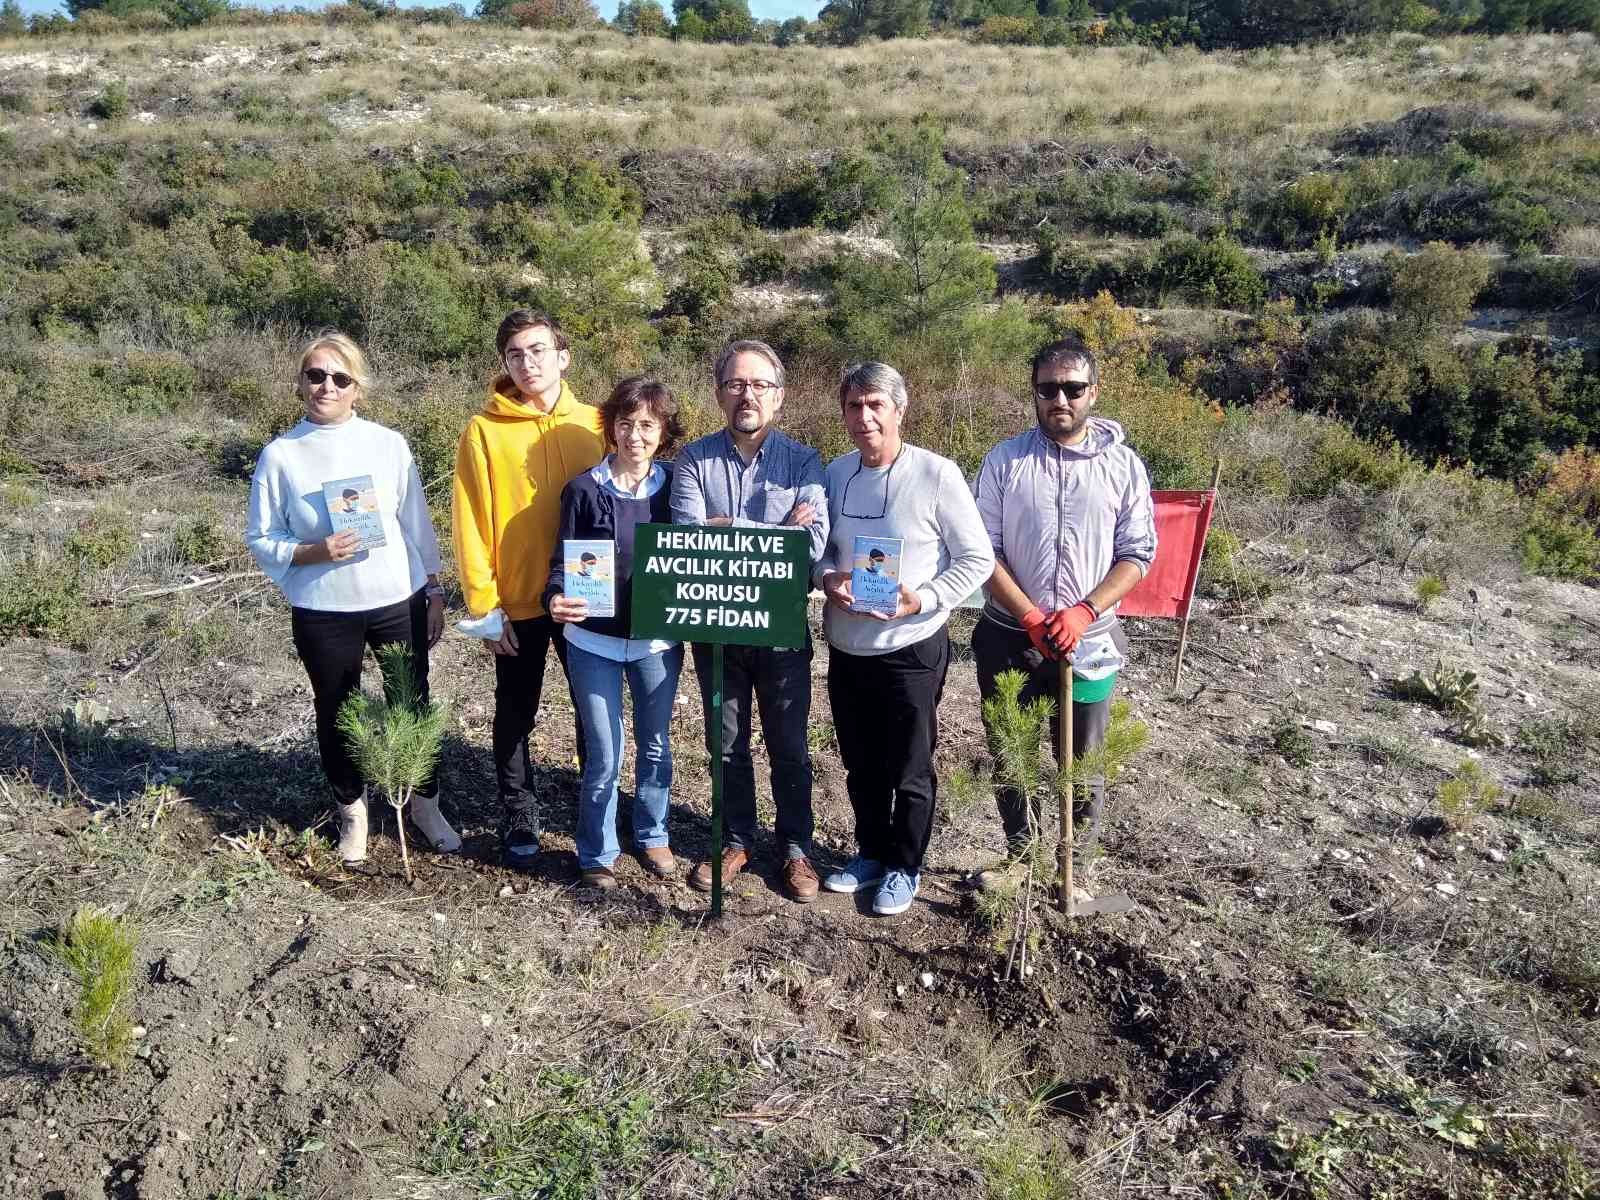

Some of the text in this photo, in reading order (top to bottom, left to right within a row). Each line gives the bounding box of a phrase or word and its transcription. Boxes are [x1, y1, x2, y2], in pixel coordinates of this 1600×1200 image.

[657, 530, 784, 553] HEKİMLİK VE
[645, 556, 793, 579] AVCILIK KİTABI
[676, 582, 760, 603] KORUSU
[665, 606, 769, 628] 775 FİDAN
